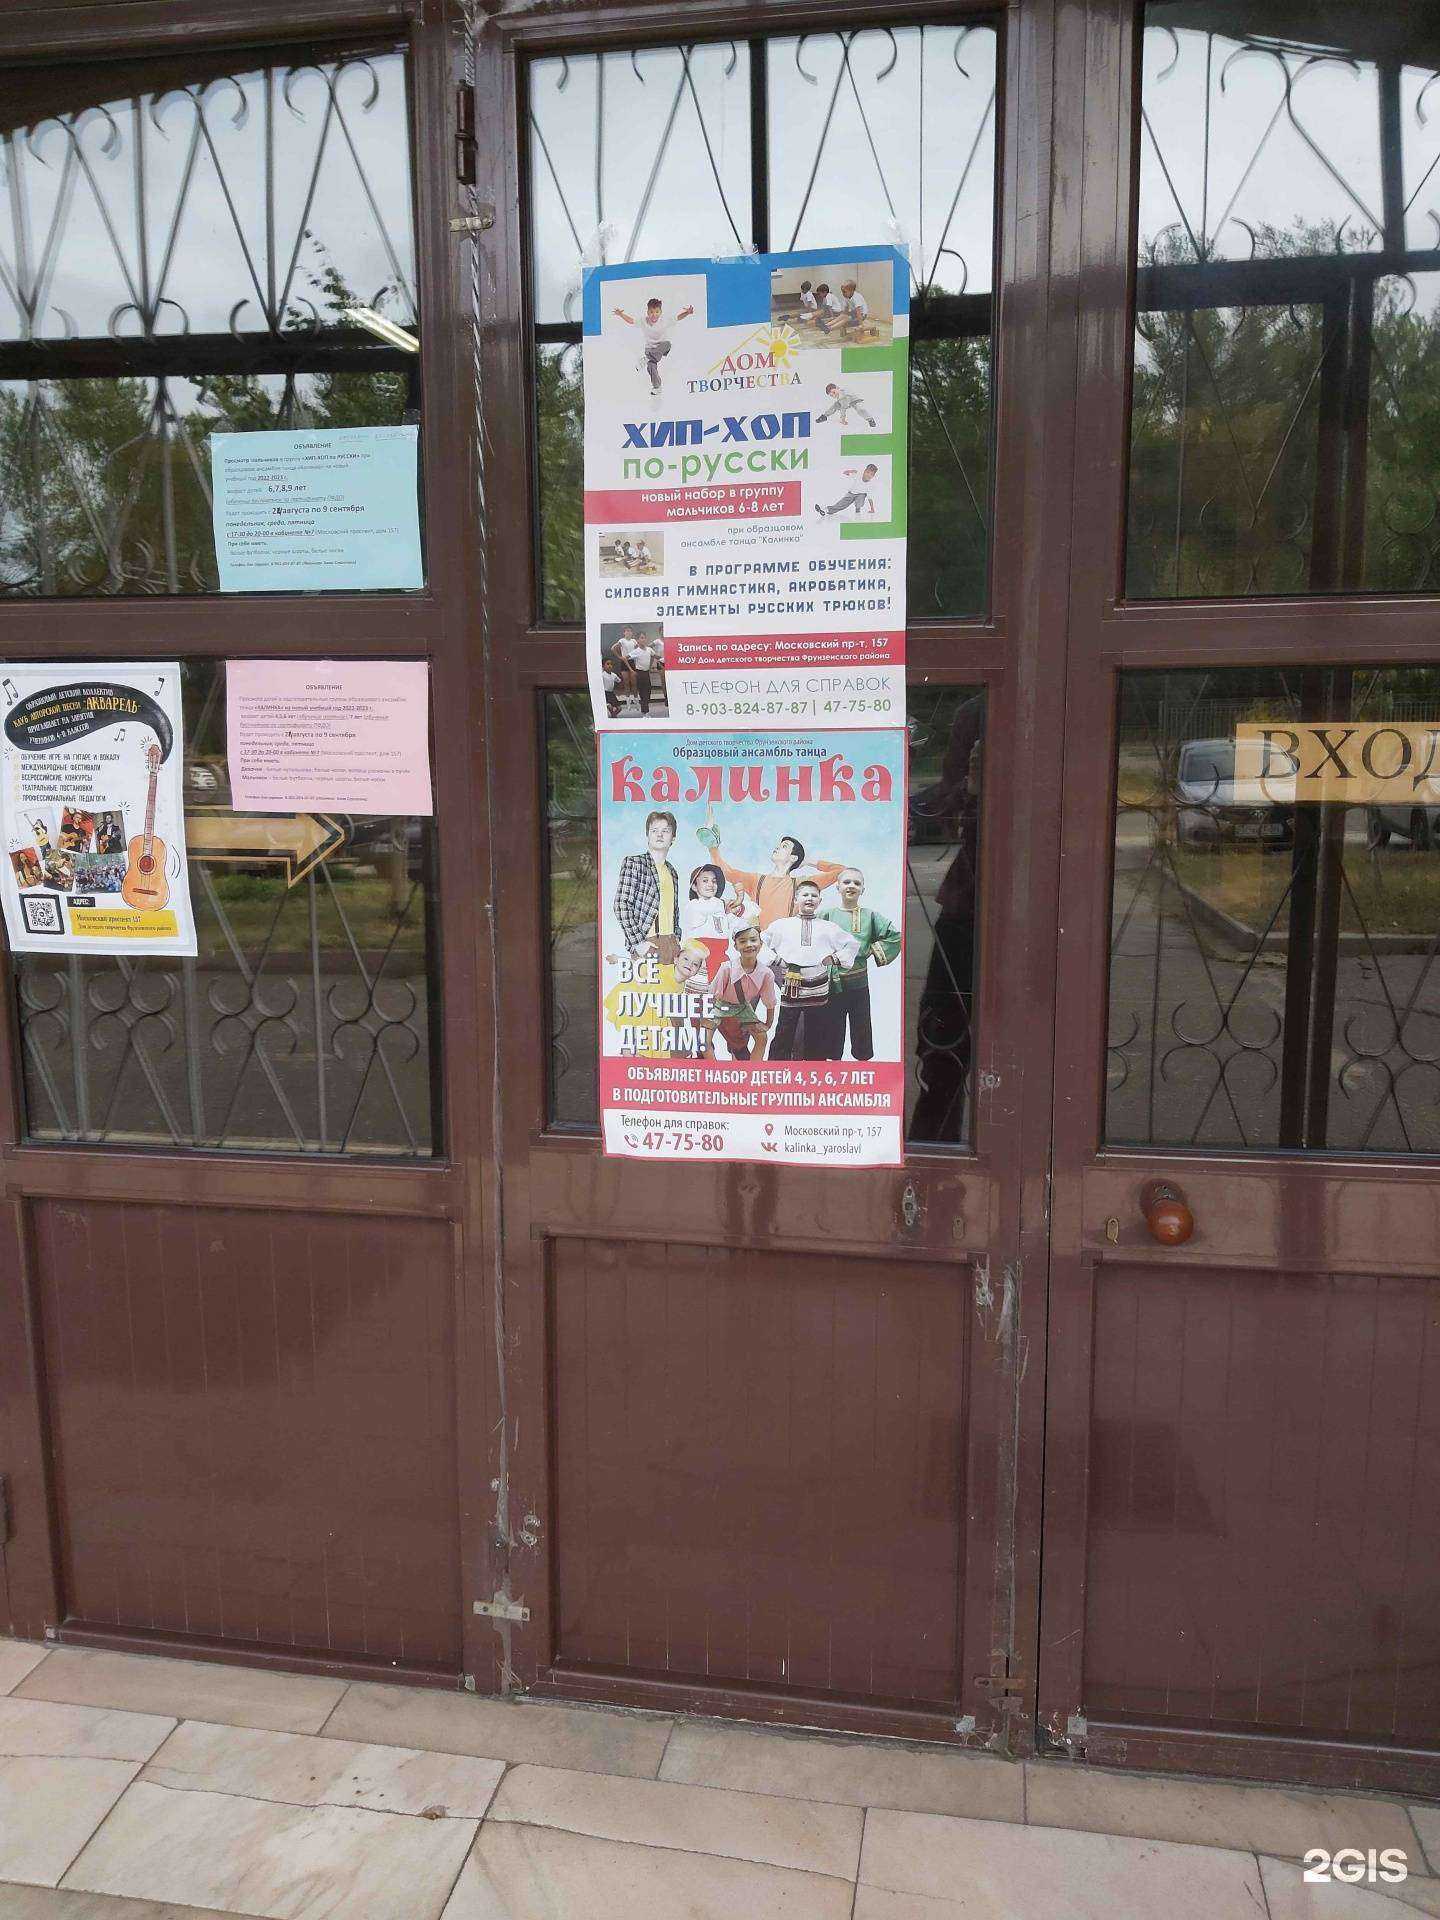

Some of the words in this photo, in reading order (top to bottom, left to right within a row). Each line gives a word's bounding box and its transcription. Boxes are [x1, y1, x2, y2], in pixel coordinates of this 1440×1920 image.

[720, 351, 776, 376] ДОМ
[686, 372, 802, 394] ТВОРЧЕСТВА
[622, 411, 811, 449] ХИП-ХОП
[293, 442, 332, 450] ОБЪЯВЛЕНИЕ
[623, 448, 809, 484] по-русски
[268, 484, 293, 493] 6,7,8,9
[641, 490, 682, 503] новый
[684, 488, 726, 501] набор
[729, 489, 737, 498] в
[740, 486, 784, 500] группу
[282, 506, 310, 515] августа
[322, 505, 328, 513] 9
[329, 504, 365, 514] сентября
[666, 503, 735, 517] мальчиков
[738, 501, 760, 514] 6-8
[763, 501, 785, 512] лет
[727, 526, 746, 536] при
[746, 523, 804, 534] образцовом
[680, 536, 727, 548] ансамбле
[729, 536, 757, 546] танца
[757, 533, 804, 545] "Калинка"
[689, 565, 698, 577] В
[705, 561, 800, 576] ПРОГРАММЕ
[808, 557, 892, 573] ОБУЧЕНИЯ:
[604, 585, 670, 599] СИЛОВАЯ
[677, 582, 780, 597] ГИМНАСТИКА,
[788, 579, 891, 594] АКРОБАТИКА,
[656, 604, 740, 617] ЭЛЕМЕНТЫ
[748, 601, 814, 615] РУССКИХ
[824, 596, 891, 612] ТРЮКОВ!
[677, 641, 713, 655] Запись
[715, 643, 728, 652] по
[730, 641, 772, 655] адресу:
[774, 638, 839, 652] Московский
[841, 639, 869, 651] пр-т,
[871, 637, 889, 648] 157
[678, 656, 696, 665] МОУ
[697, 655, 715, 665] Дом
[716, 655, 752, 665] детского
[754, 653, 800, 664] творчества
[801, 653, 857, 664] Фрунзенского
[858, 652, 890, 662] района
[681, 680, 761, 695] ТЕЛЕФОН
[766, 679, 801, 694] ДЛЯ
[806, 677, 891, 693] СПРАВОК
[686, 699, 808, 715] 8-903-824-87-87
[823, 698, 891, 713] 47-75-80
[20, 753, 47, 761] ОБУЧЕНИЕ
[48, 753, 61, 761] ИГРЕ
[63, 753, 71, 761] НА
[72, 753, 91, 761] ГИТАРЕ
[99, 753, 120, 761] ВОКАЛУ
[672, 746, 739, 759] Образцовый
[741, 745, 793, 757] ансамбль
[795, 748, 827, 759] танца
[21, 763, 67, 772] МЕЖДУНАРОДНЫЕ
[70, 763, 101, 772] ФЕСТИВАЛИ
[21, 772, 62, 781] ВСЕРОССИЙСКИЕ
[64, 774, 93, 782] КОНКУРСЫ
[22, 784, 58, 792] ТЕАТРАЛЬНЫЕ
[59, 784, 93, 792] ПОСТАНОВКИ
[22, 794, 76, 803] ПРОФЕССИОНАЛЬНЫЕ
[618, 953, 661, 984] ВСЁ
[616, 992, 715, 1018] ЛУЧШЕЕ
[619, 1025, 708, 1054] ДЕТЯМ!
[627, 1066, 702, 1082] ОБЪЯВЛЯЕТ
[704, 1069, 748, 1083] НАБОР
[750, 1068, 792, 1086] ДЕТЕЙ
[794, 1071, 806, 1087] 4,
[809, 1071, 821, 1087] 5,
[824, 1071, 838, 1087] 6,
[840, 1071, 849, 1085] 7
[850, 1071, 875, 1086] ЛЕТ
[612, 1087, 622, 1101] В
[624, 1088, 759, 1107] ПОДГОТОВИТЕЛЬНЫЕ
[761, 1092, 816, 1108] ГРУППЫ
[818, 1093, 891, 1108] АНСАМБЛЯ
[620, 1114, 662, 1130] Телефон
[664, 1117, 681, 1131] для
[681, 1119, 730, 1134] справок:
[783, 1124, 840, 1138] Московский
[841, 1126, 864, 1140] пр-т,
[866, 1126, 882, 1138] 157
[642, 1132, 724, 1152] 47-75-80
[784, 1140, 862, 1156] kalinka_yaroslavl
